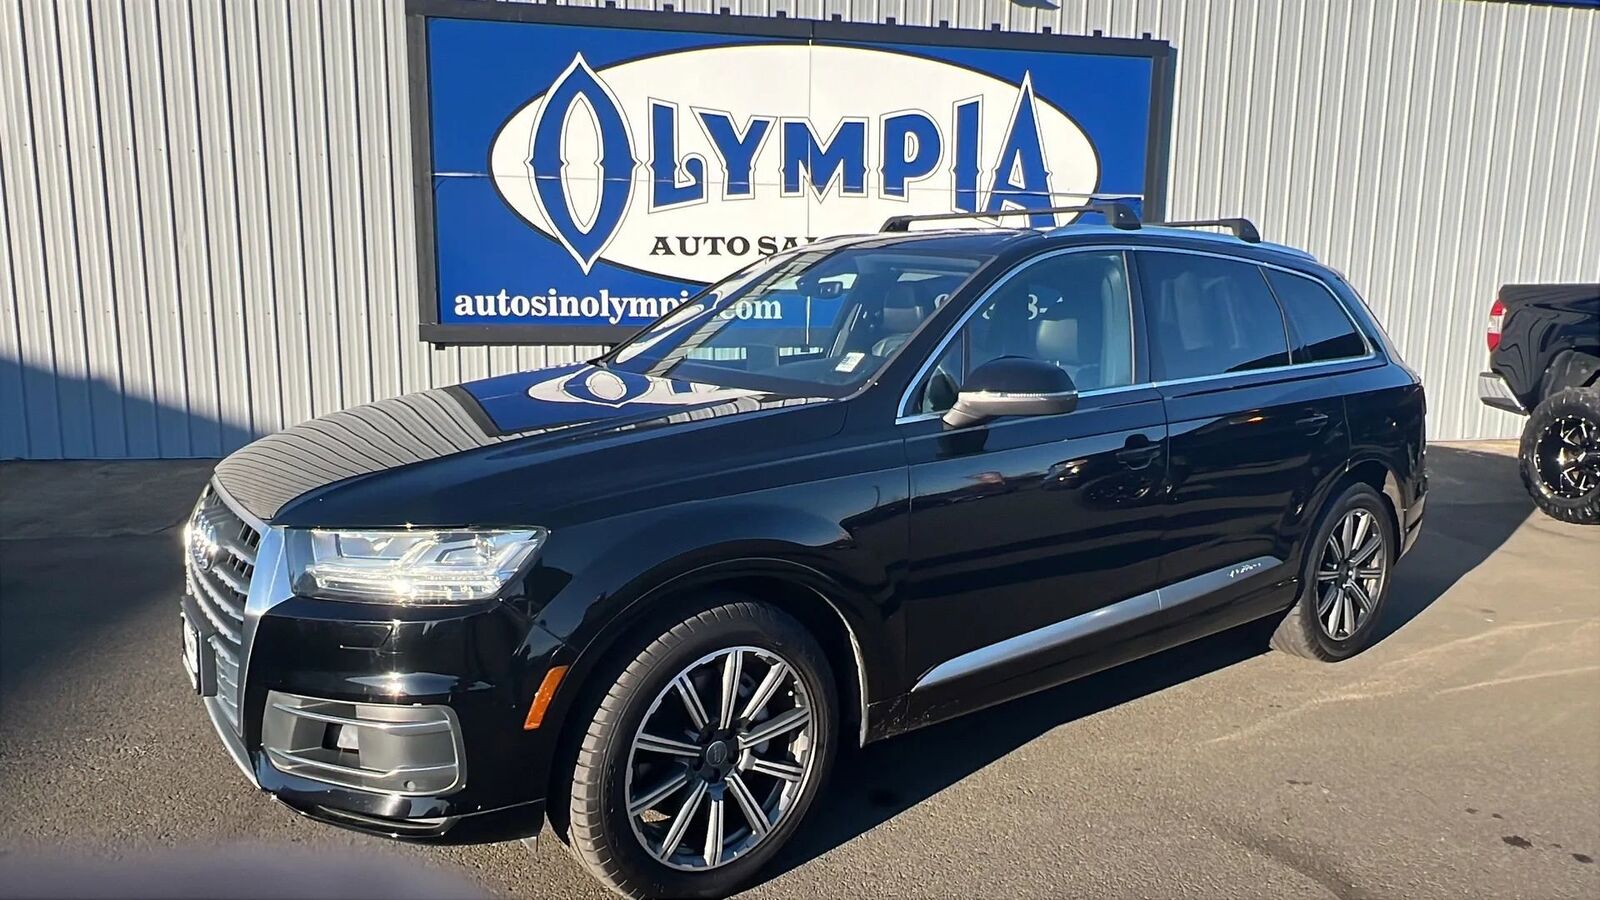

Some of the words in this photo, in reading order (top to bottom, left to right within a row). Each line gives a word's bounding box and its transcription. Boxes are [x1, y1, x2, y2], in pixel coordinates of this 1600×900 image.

[526, 52, 1058, 275] OLYMPIA
[649, 236, 750, 256] AUTO
[757, 236, 819, 257] SA
